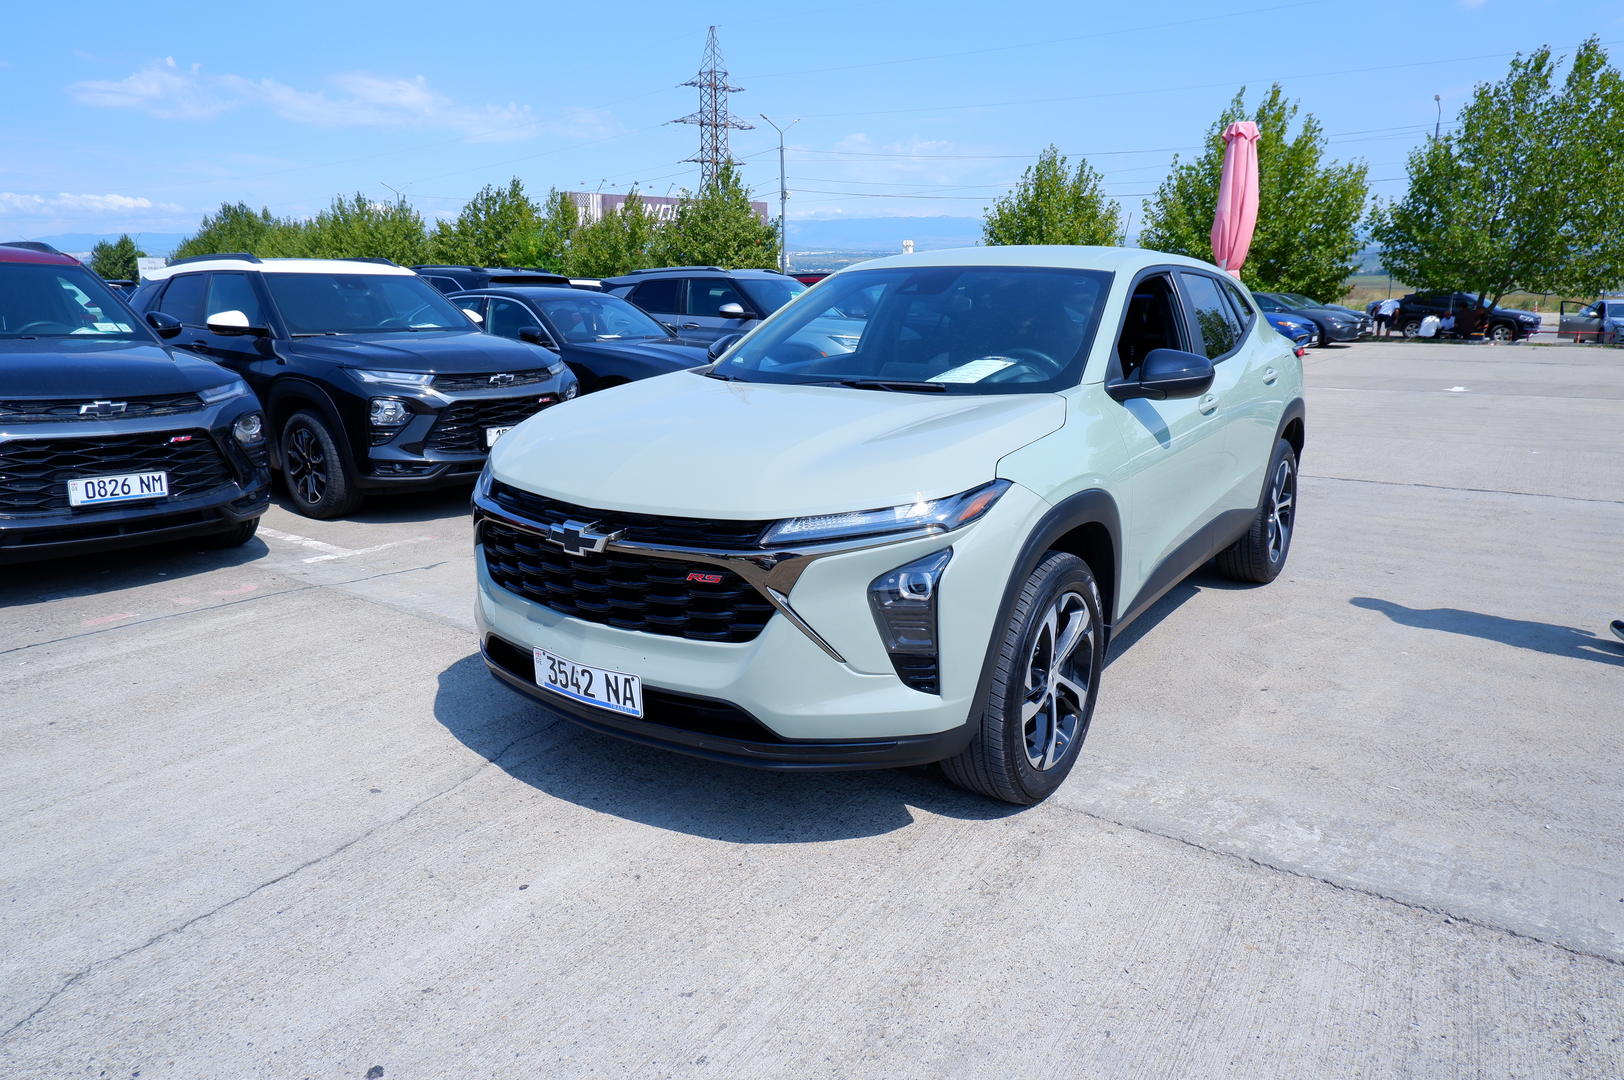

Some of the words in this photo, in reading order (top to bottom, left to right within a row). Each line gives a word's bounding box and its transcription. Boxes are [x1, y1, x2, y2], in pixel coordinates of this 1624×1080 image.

[84, 478, 131, 500] 0826
[139, 474, 164, 494] NM
[686, 572, 723, 584] RS
[546, 655, 596, 699] 3542
[604, 673, 636, 709] NA
